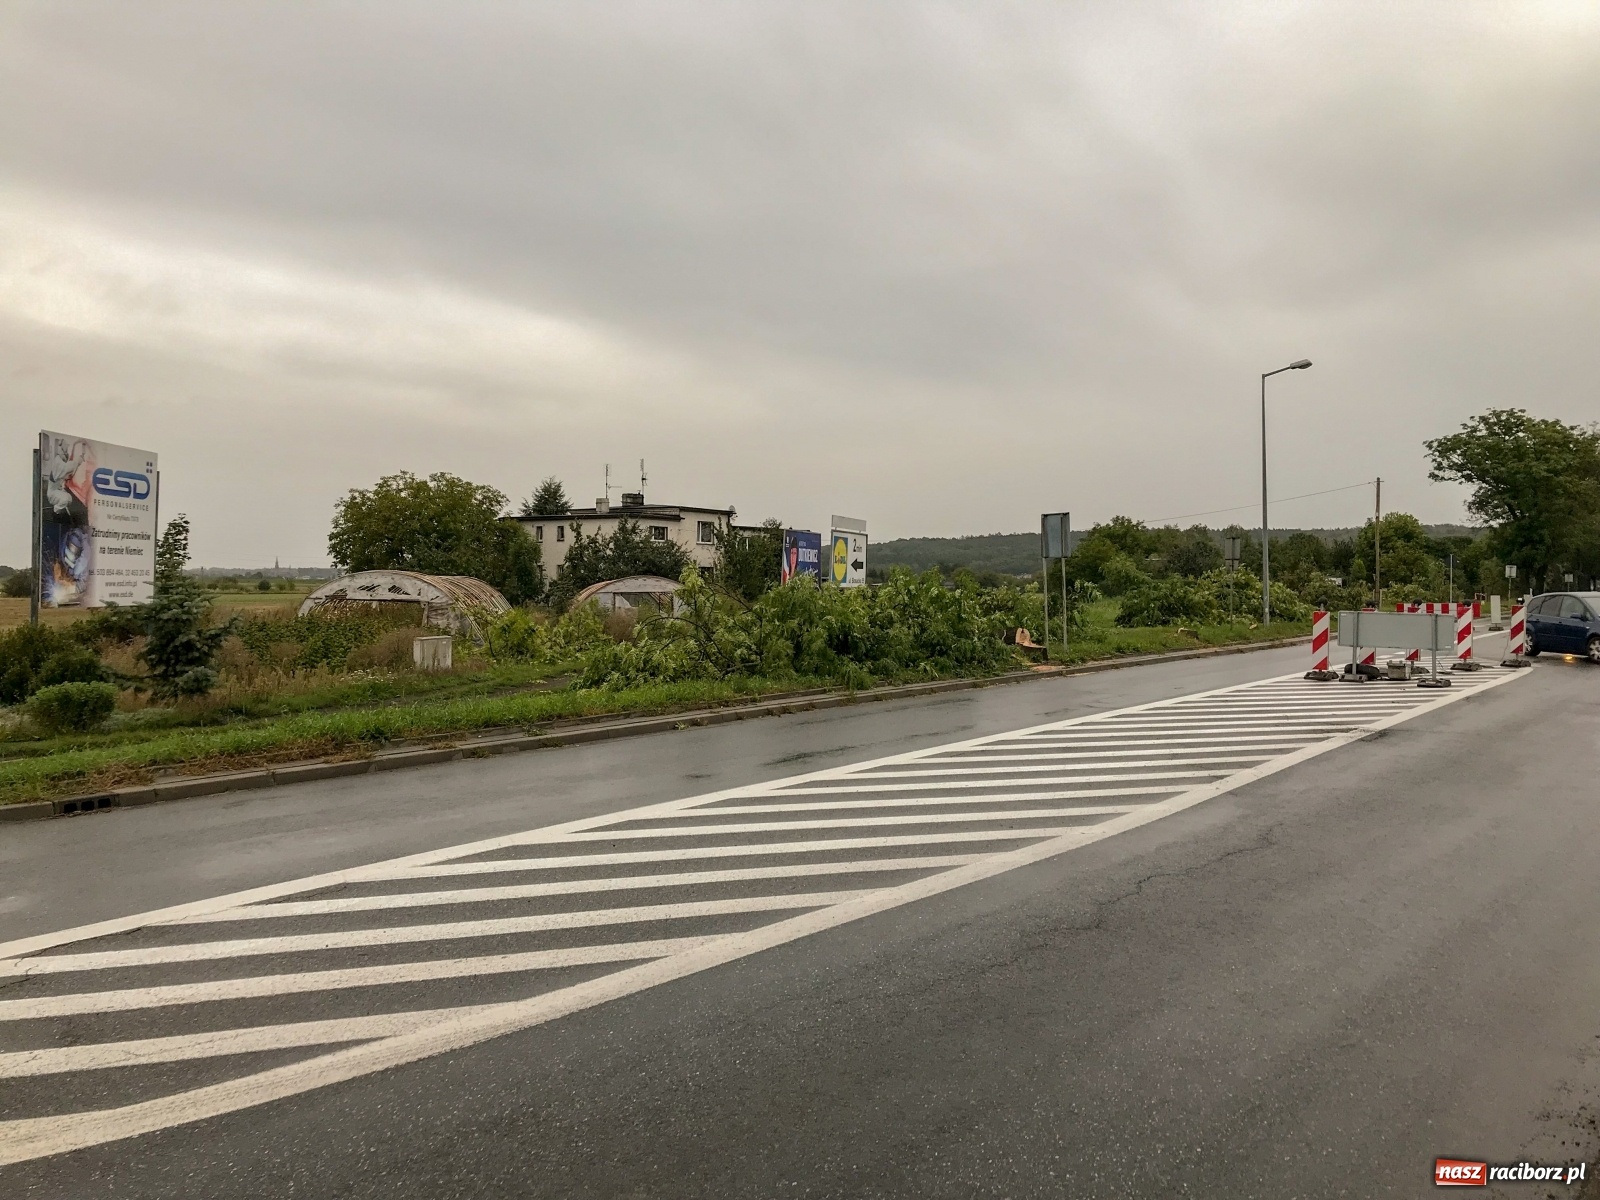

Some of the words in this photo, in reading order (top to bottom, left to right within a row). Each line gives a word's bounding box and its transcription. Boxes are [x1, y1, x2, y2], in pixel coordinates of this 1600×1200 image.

[92, 467, 150, 500] ESD
[93, 499, 149, 512] PERSONALSERVICE
[91, 527, 120, 541] Zatrudnimy
[121, 531, 151, 541] pracowników
[99, 546, 106, 555] na
[107, 546, 124, 555] terenie
[125, 546, 144, 556] Niemiec
[853, 538, 857, 552] 2
